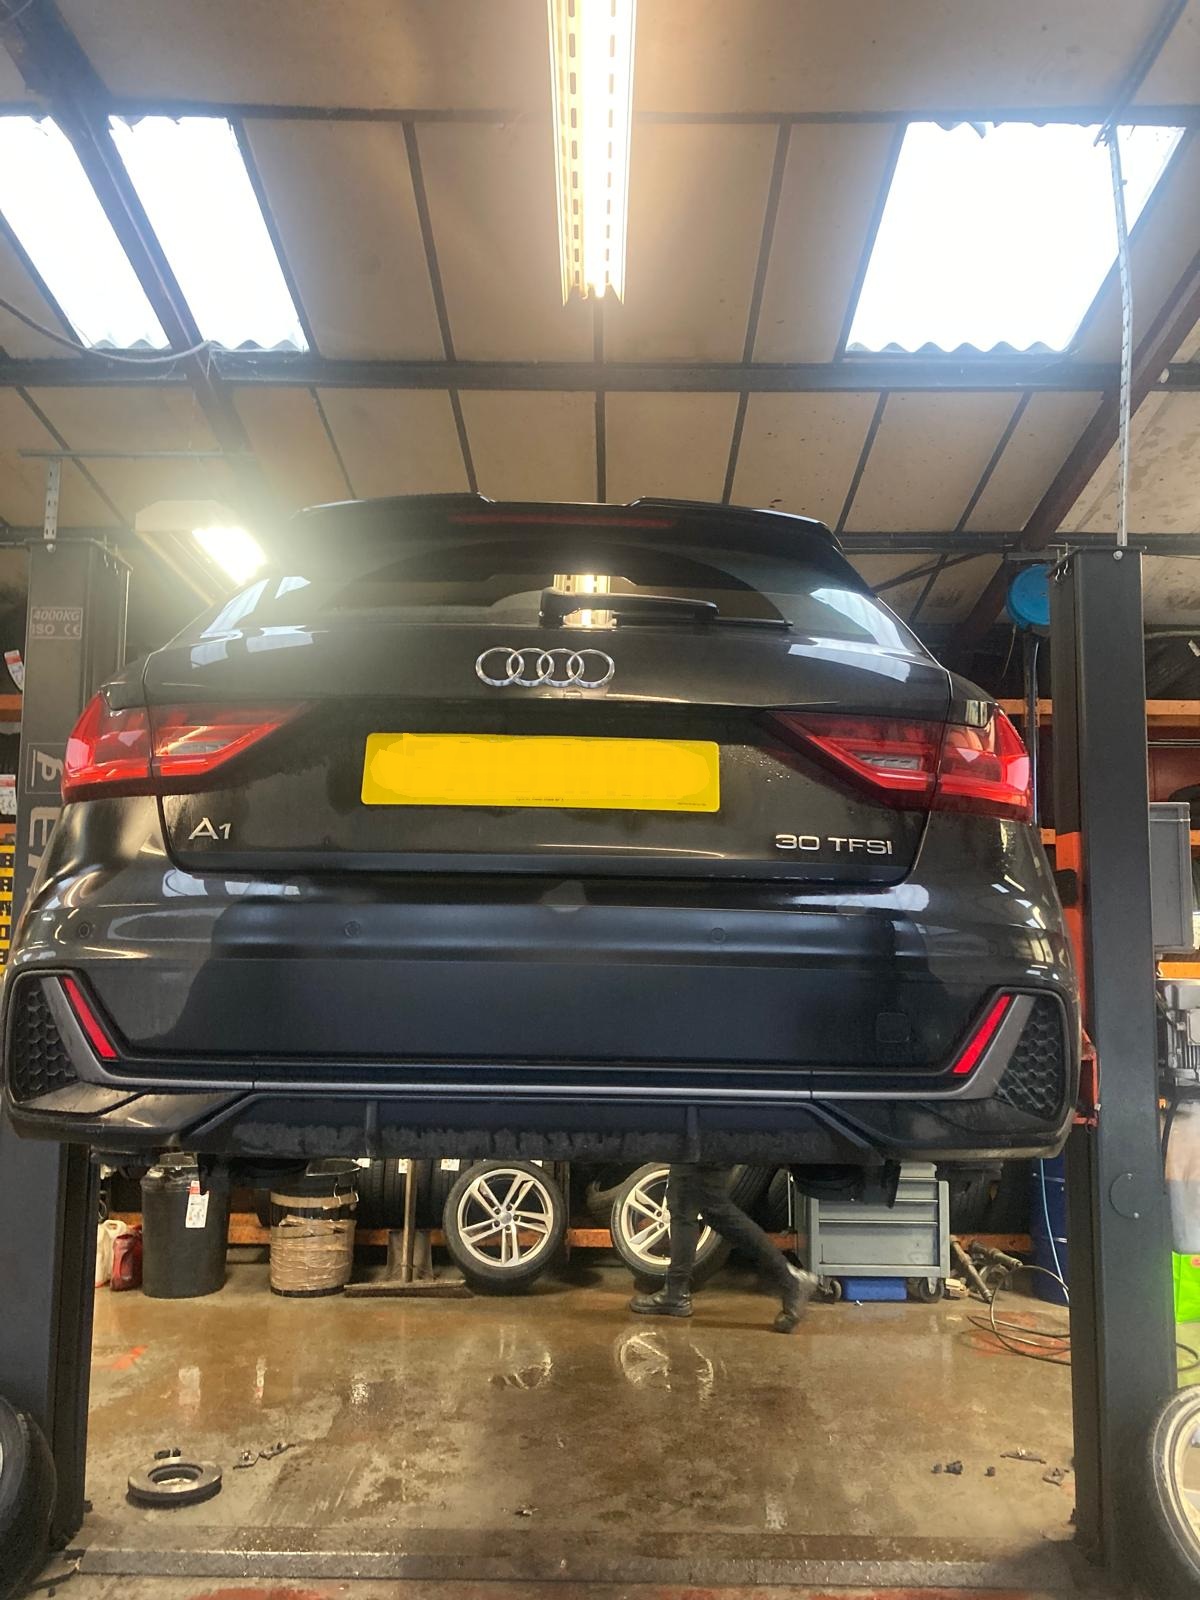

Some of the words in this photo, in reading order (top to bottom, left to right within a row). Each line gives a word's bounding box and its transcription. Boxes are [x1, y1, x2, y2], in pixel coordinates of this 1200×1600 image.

[33, 609, 80, 622] 4000KG
[31, 623, 55, 635] ISO
[188, 817, 231, 840] A1
[775, 834, 820, 851] 30
[827, 837, 893, 855] TFSI
